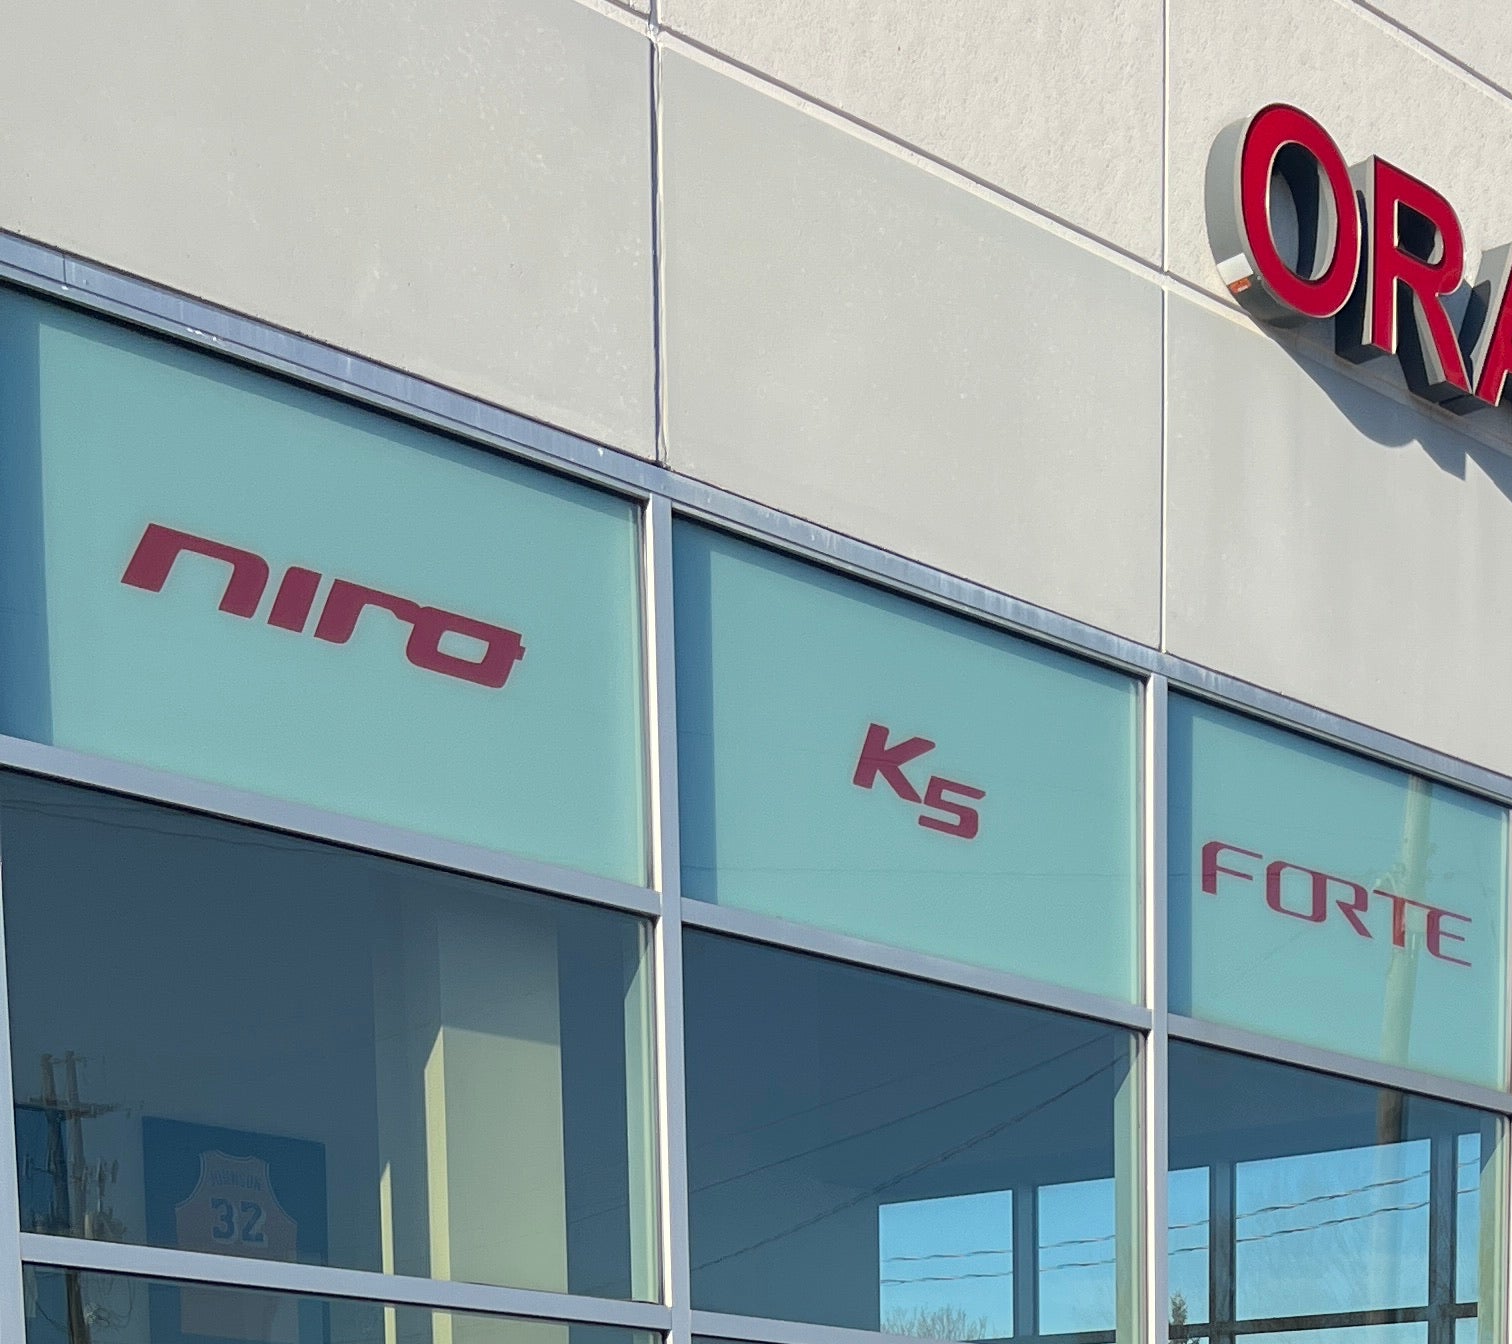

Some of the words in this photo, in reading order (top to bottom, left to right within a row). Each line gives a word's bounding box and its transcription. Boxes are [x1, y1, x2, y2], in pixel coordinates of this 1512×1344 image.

[853, 722, 987, 840] K5
[1201, 840, 1473, 968] FORTE
[210, 1198, 265, 1242] 32
